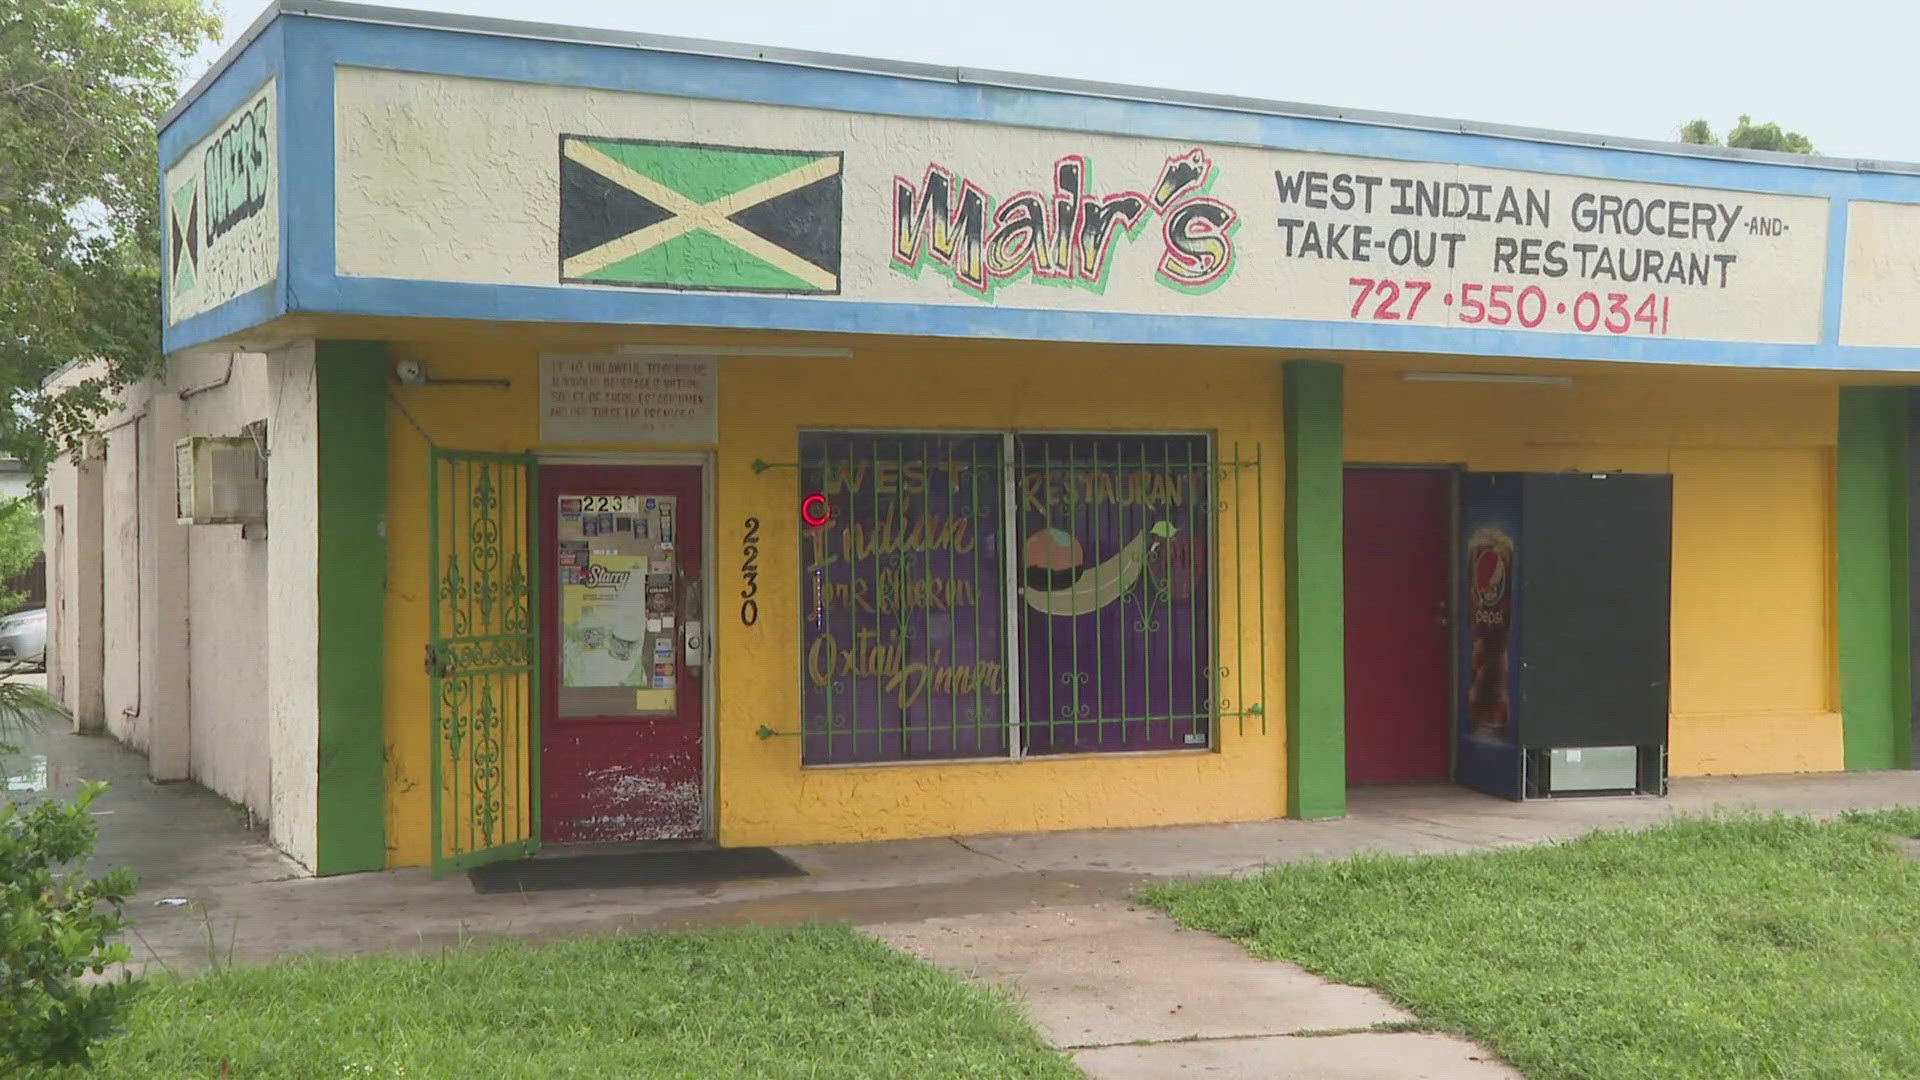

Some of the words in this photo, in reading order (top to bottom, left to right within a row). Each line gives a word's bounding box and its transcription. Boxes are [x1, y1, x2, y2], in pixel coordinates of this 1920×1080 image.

[205, 97, 268, 248] MAIRS
[1275, 170, 1383, 214] WEST
[1390, 179, 1550, 228] INDIAN
[1571, 193, 1743, 243] GROCERY
[892, 148, 1240, 303] Mair's
[1277, 218, 1466, 269] TAKE-OUT
[1493, 237, 1737, 289] RESTAURANT
[822, 460, 969, 495] WEST
[1021, 470, 1200, 513] RESTAURANT
[803, 495, 976, 572] Indian
[741, 517, 760, 627] 2230
